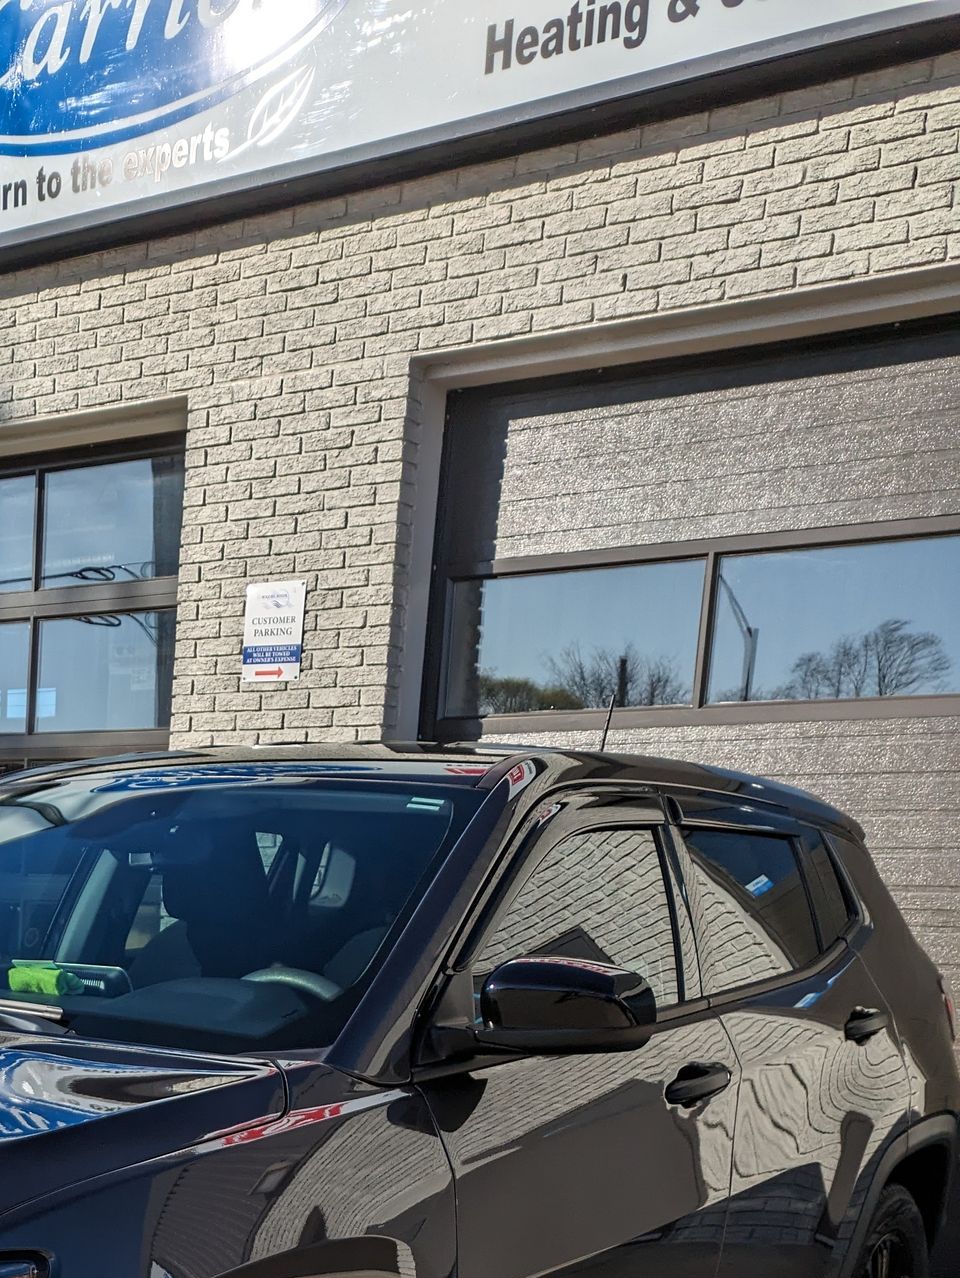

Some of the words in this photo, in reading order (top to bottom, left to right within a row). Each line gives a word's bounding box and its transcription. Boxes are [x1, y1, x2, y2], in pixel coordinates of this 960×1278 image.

[484, 0, 649, 75] Heating
[36, 166, 62, 202] to
[70, 154, 113, 193] the
[122, 121, 230, 182] experts
[252, 616, 296, 625] CUSTOMER
[254, 628, 292, 637] PARKING
